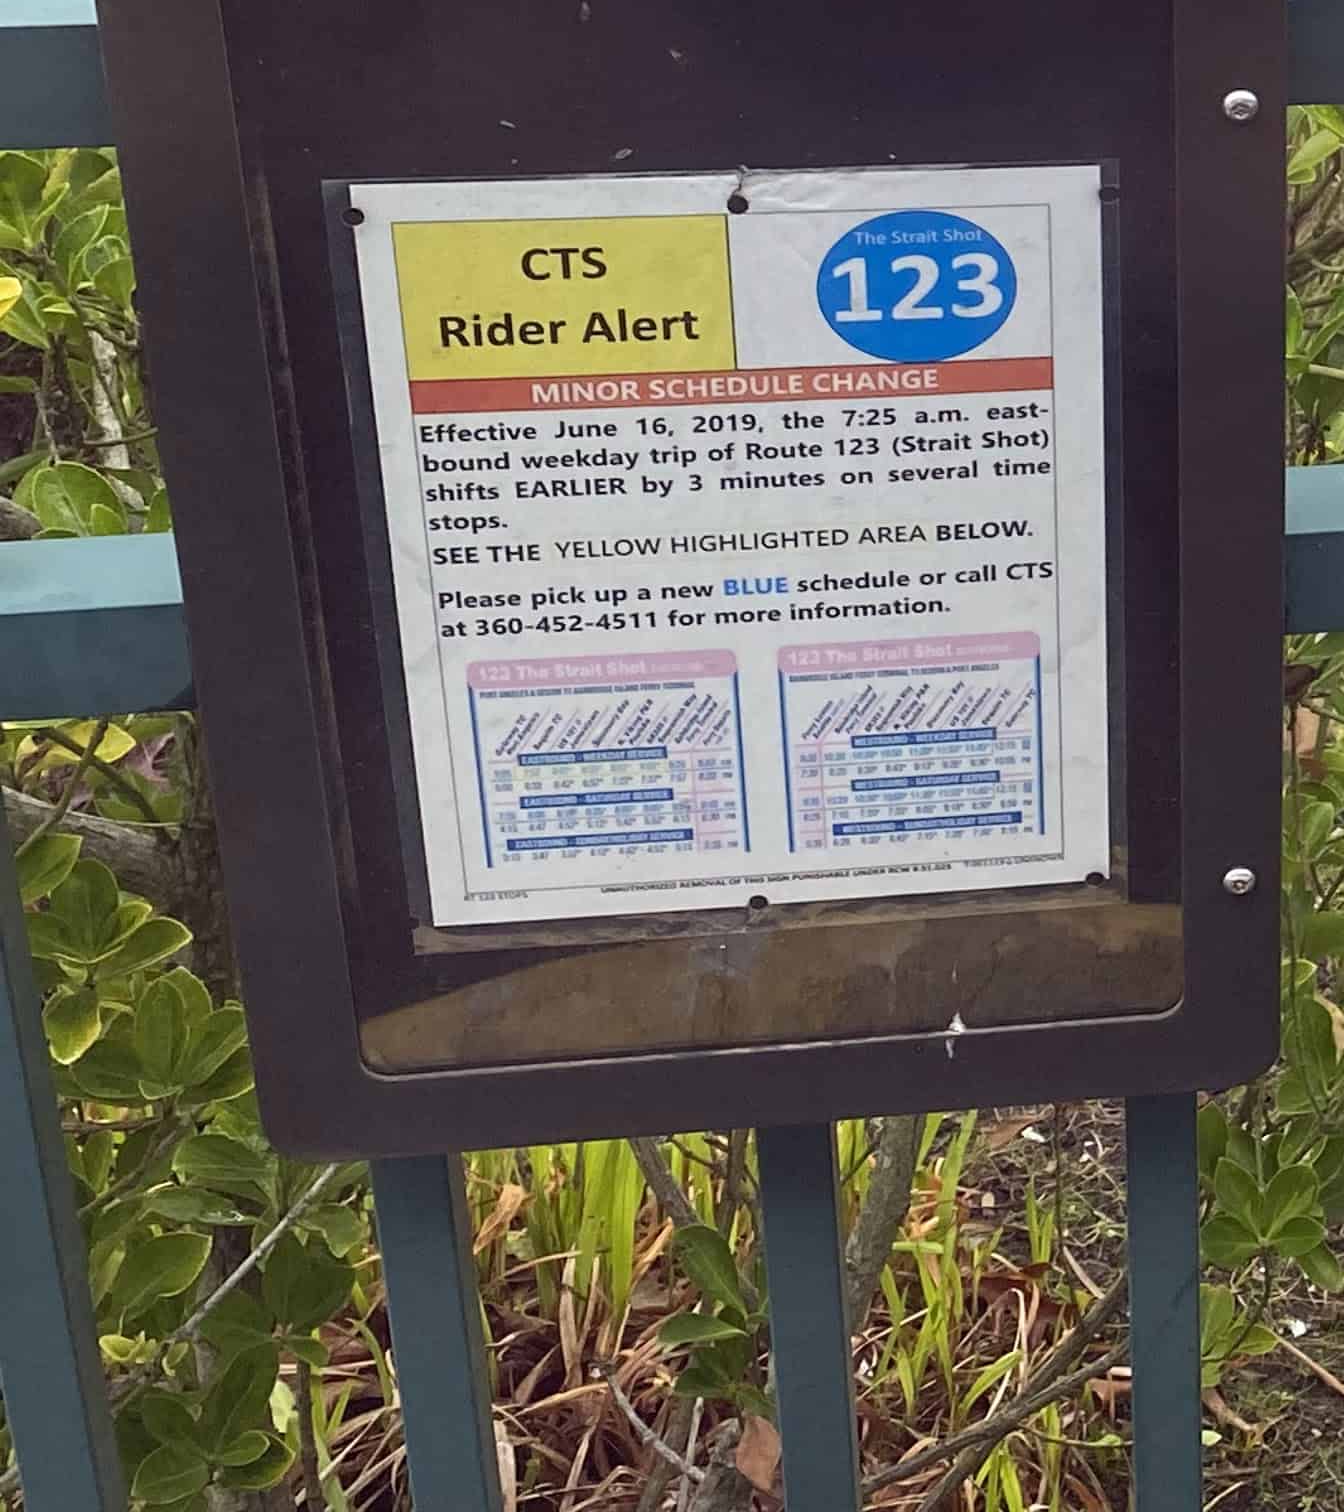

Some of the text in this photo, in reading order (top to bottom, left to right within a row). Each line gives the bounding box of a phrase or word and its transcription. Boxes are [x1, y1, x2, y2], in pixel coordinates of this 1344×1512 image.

[854, 228, 982, 246] The Strait Shot
[521, 247, 607, 280] CTS
[832, 252, 1003, 322] 123
[439, 308, 699, 348] Rider Alert
[532, 368, 939, 404] MINOR SCHEDULE CHANGE
[419, 402, 1049, 443] Effective June 16, 2019, the 7:25 a.m. east-
[423, 429, 1050, 473] bound weekday trip of Route 123 (Strait Shot)
[426, 458, 1051, 502] shifts EARLIER by 3 minutes on several time
[429, 515, 508, 534] stops.
[433, 520, 1033, 565] SEE THE YELLOW HIGHLIGHTED AREA BELOW.
[438, 561, 1053, 610] Please pick up a new BLUE schedule or call CTS
[441, 598, 951, 638] at 360-452-4511 for more information.
[516, 665, 547, 680] The
[553, 662, 602, 679] Strait
[607, 660, 646, 677] Shot
[823, 648, 857, 664] The
[863, 645, 908, 662] Strait
[914, 643, 951, 658] Shot
